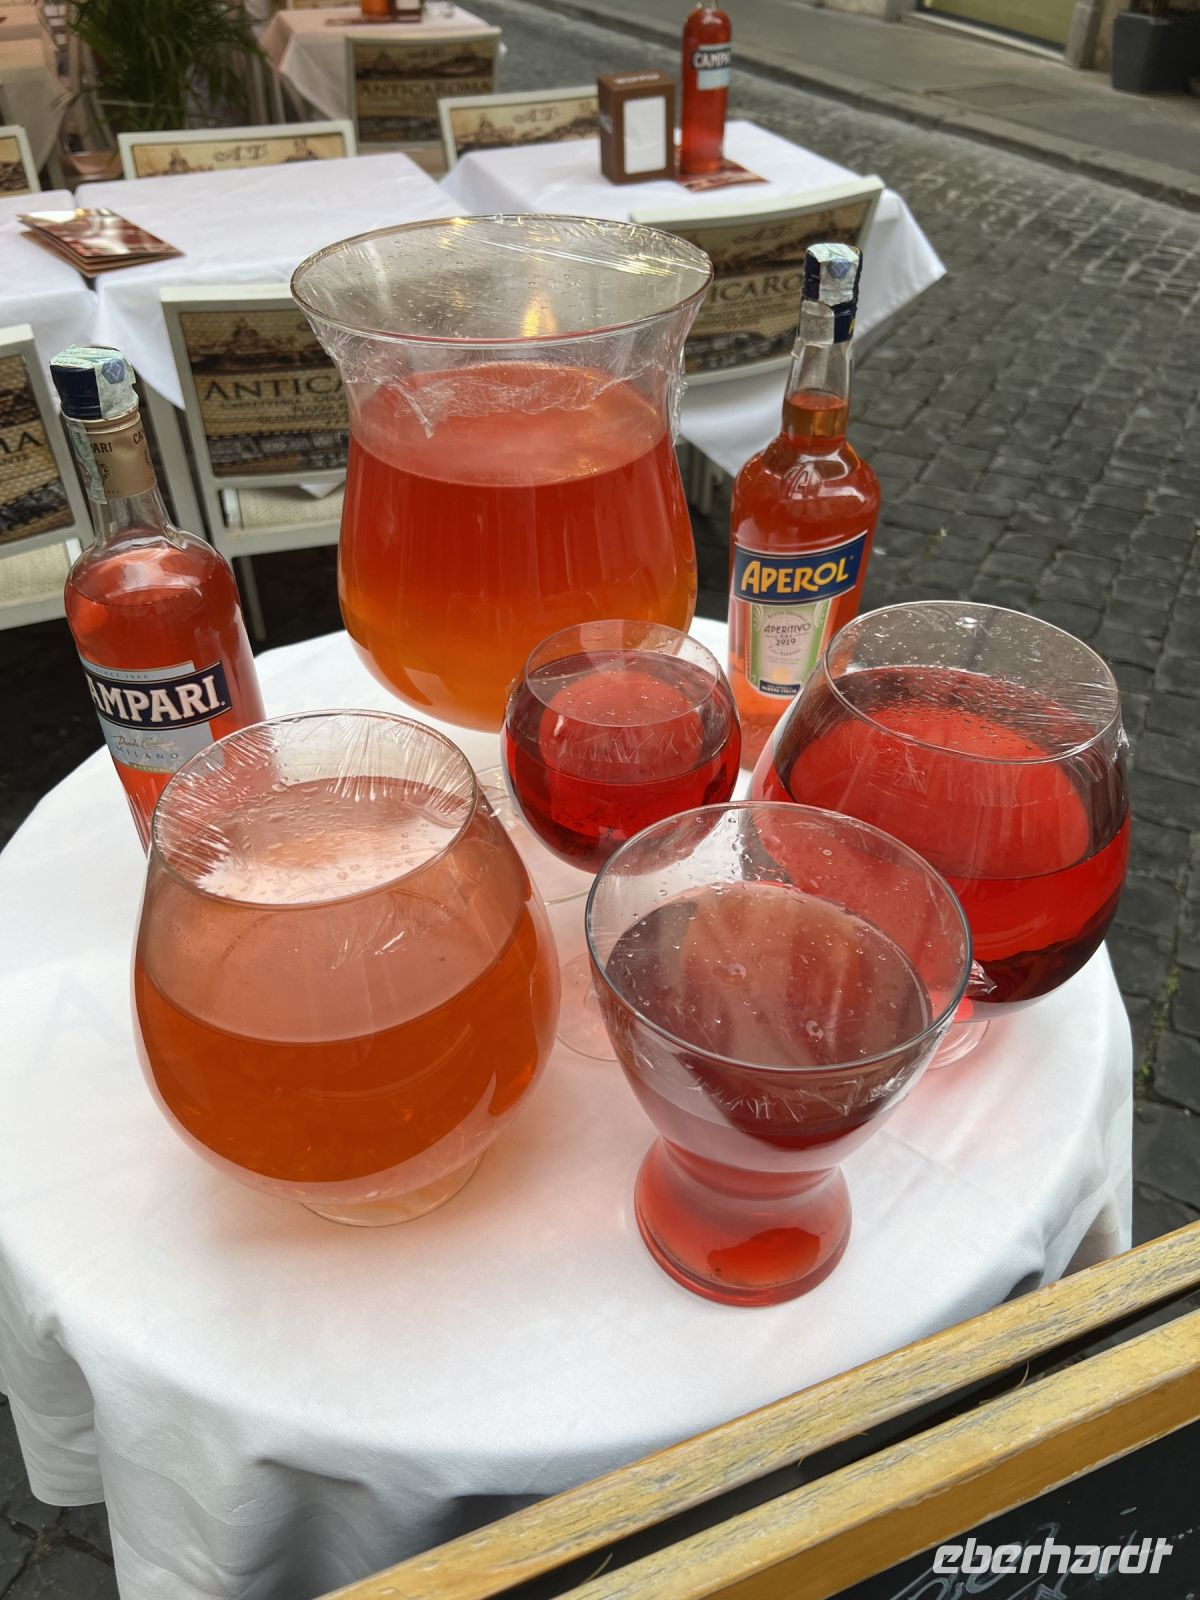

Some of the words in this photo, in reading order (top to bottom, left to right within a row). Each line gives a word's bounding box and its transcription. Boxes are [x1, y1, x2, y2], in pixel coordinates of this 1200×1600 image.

[740, 557, 849, 595] APEROL
[763, 622, 811, 634] APERITIVO
[775, 637, 797, 647] 1919
[116, 744, 180, 761] MILANO
